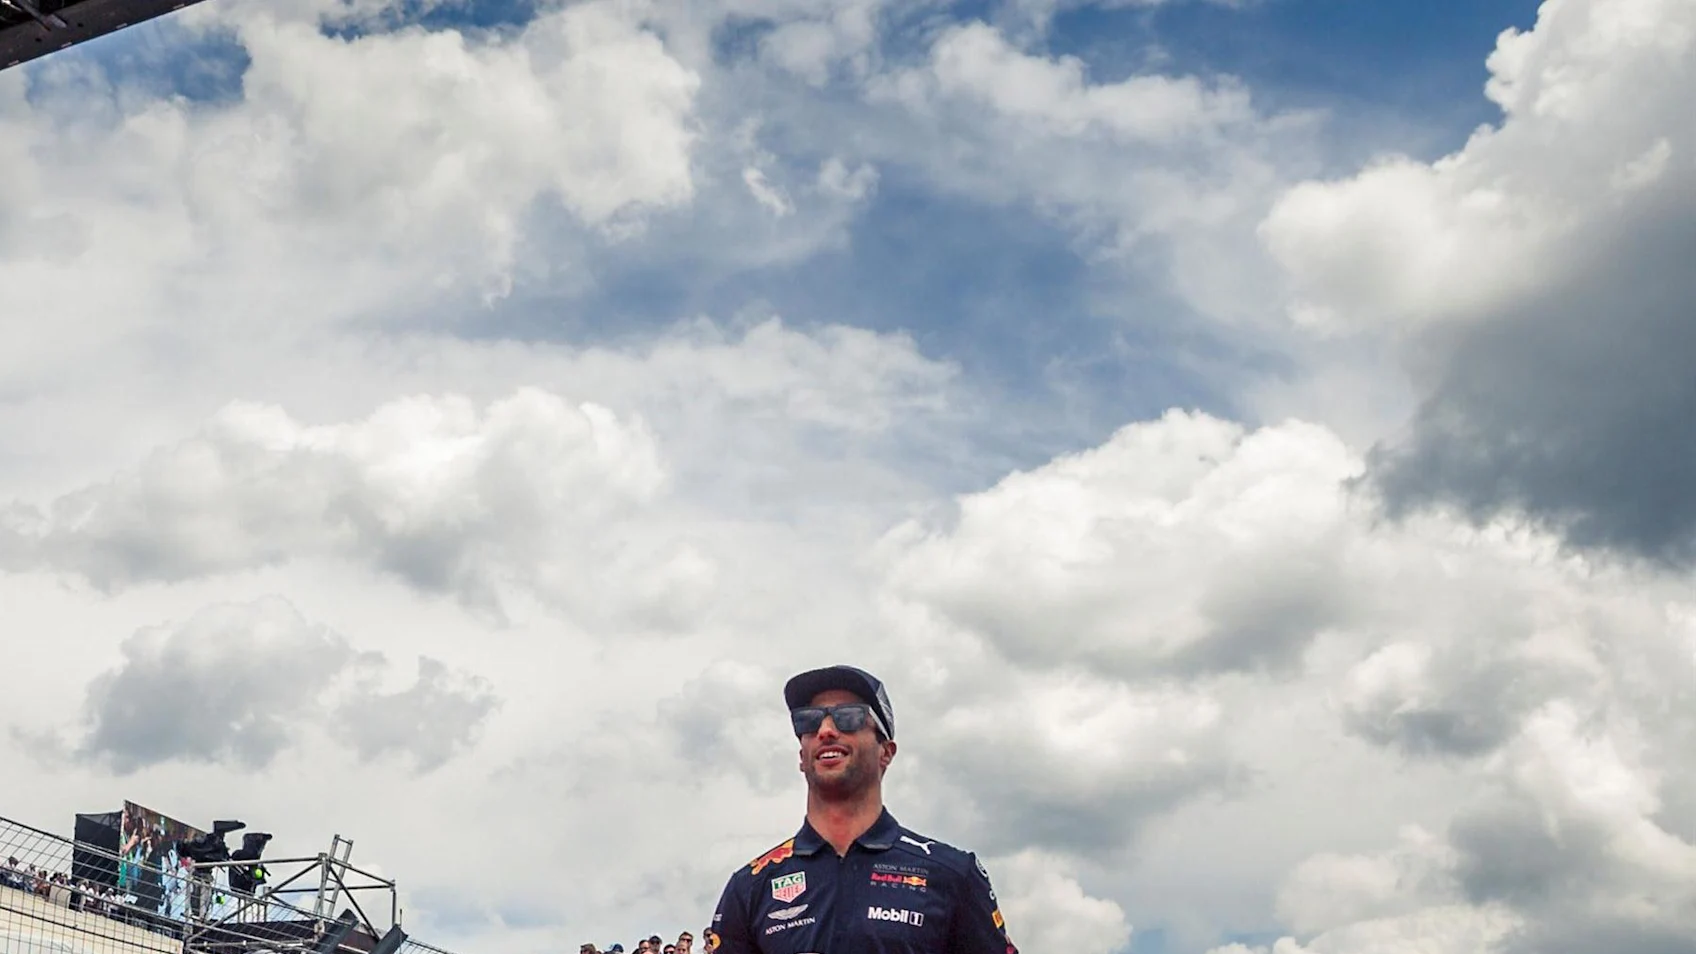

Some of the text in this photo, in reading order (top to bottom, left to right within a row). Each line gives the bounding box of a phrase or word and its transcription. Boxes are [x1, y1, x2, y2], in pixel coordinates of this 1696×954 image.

[775, 875, 802, 889] TAG
[868, 906, 909, 923] Mobil
[787, 917, 816, 929] MARTIN
